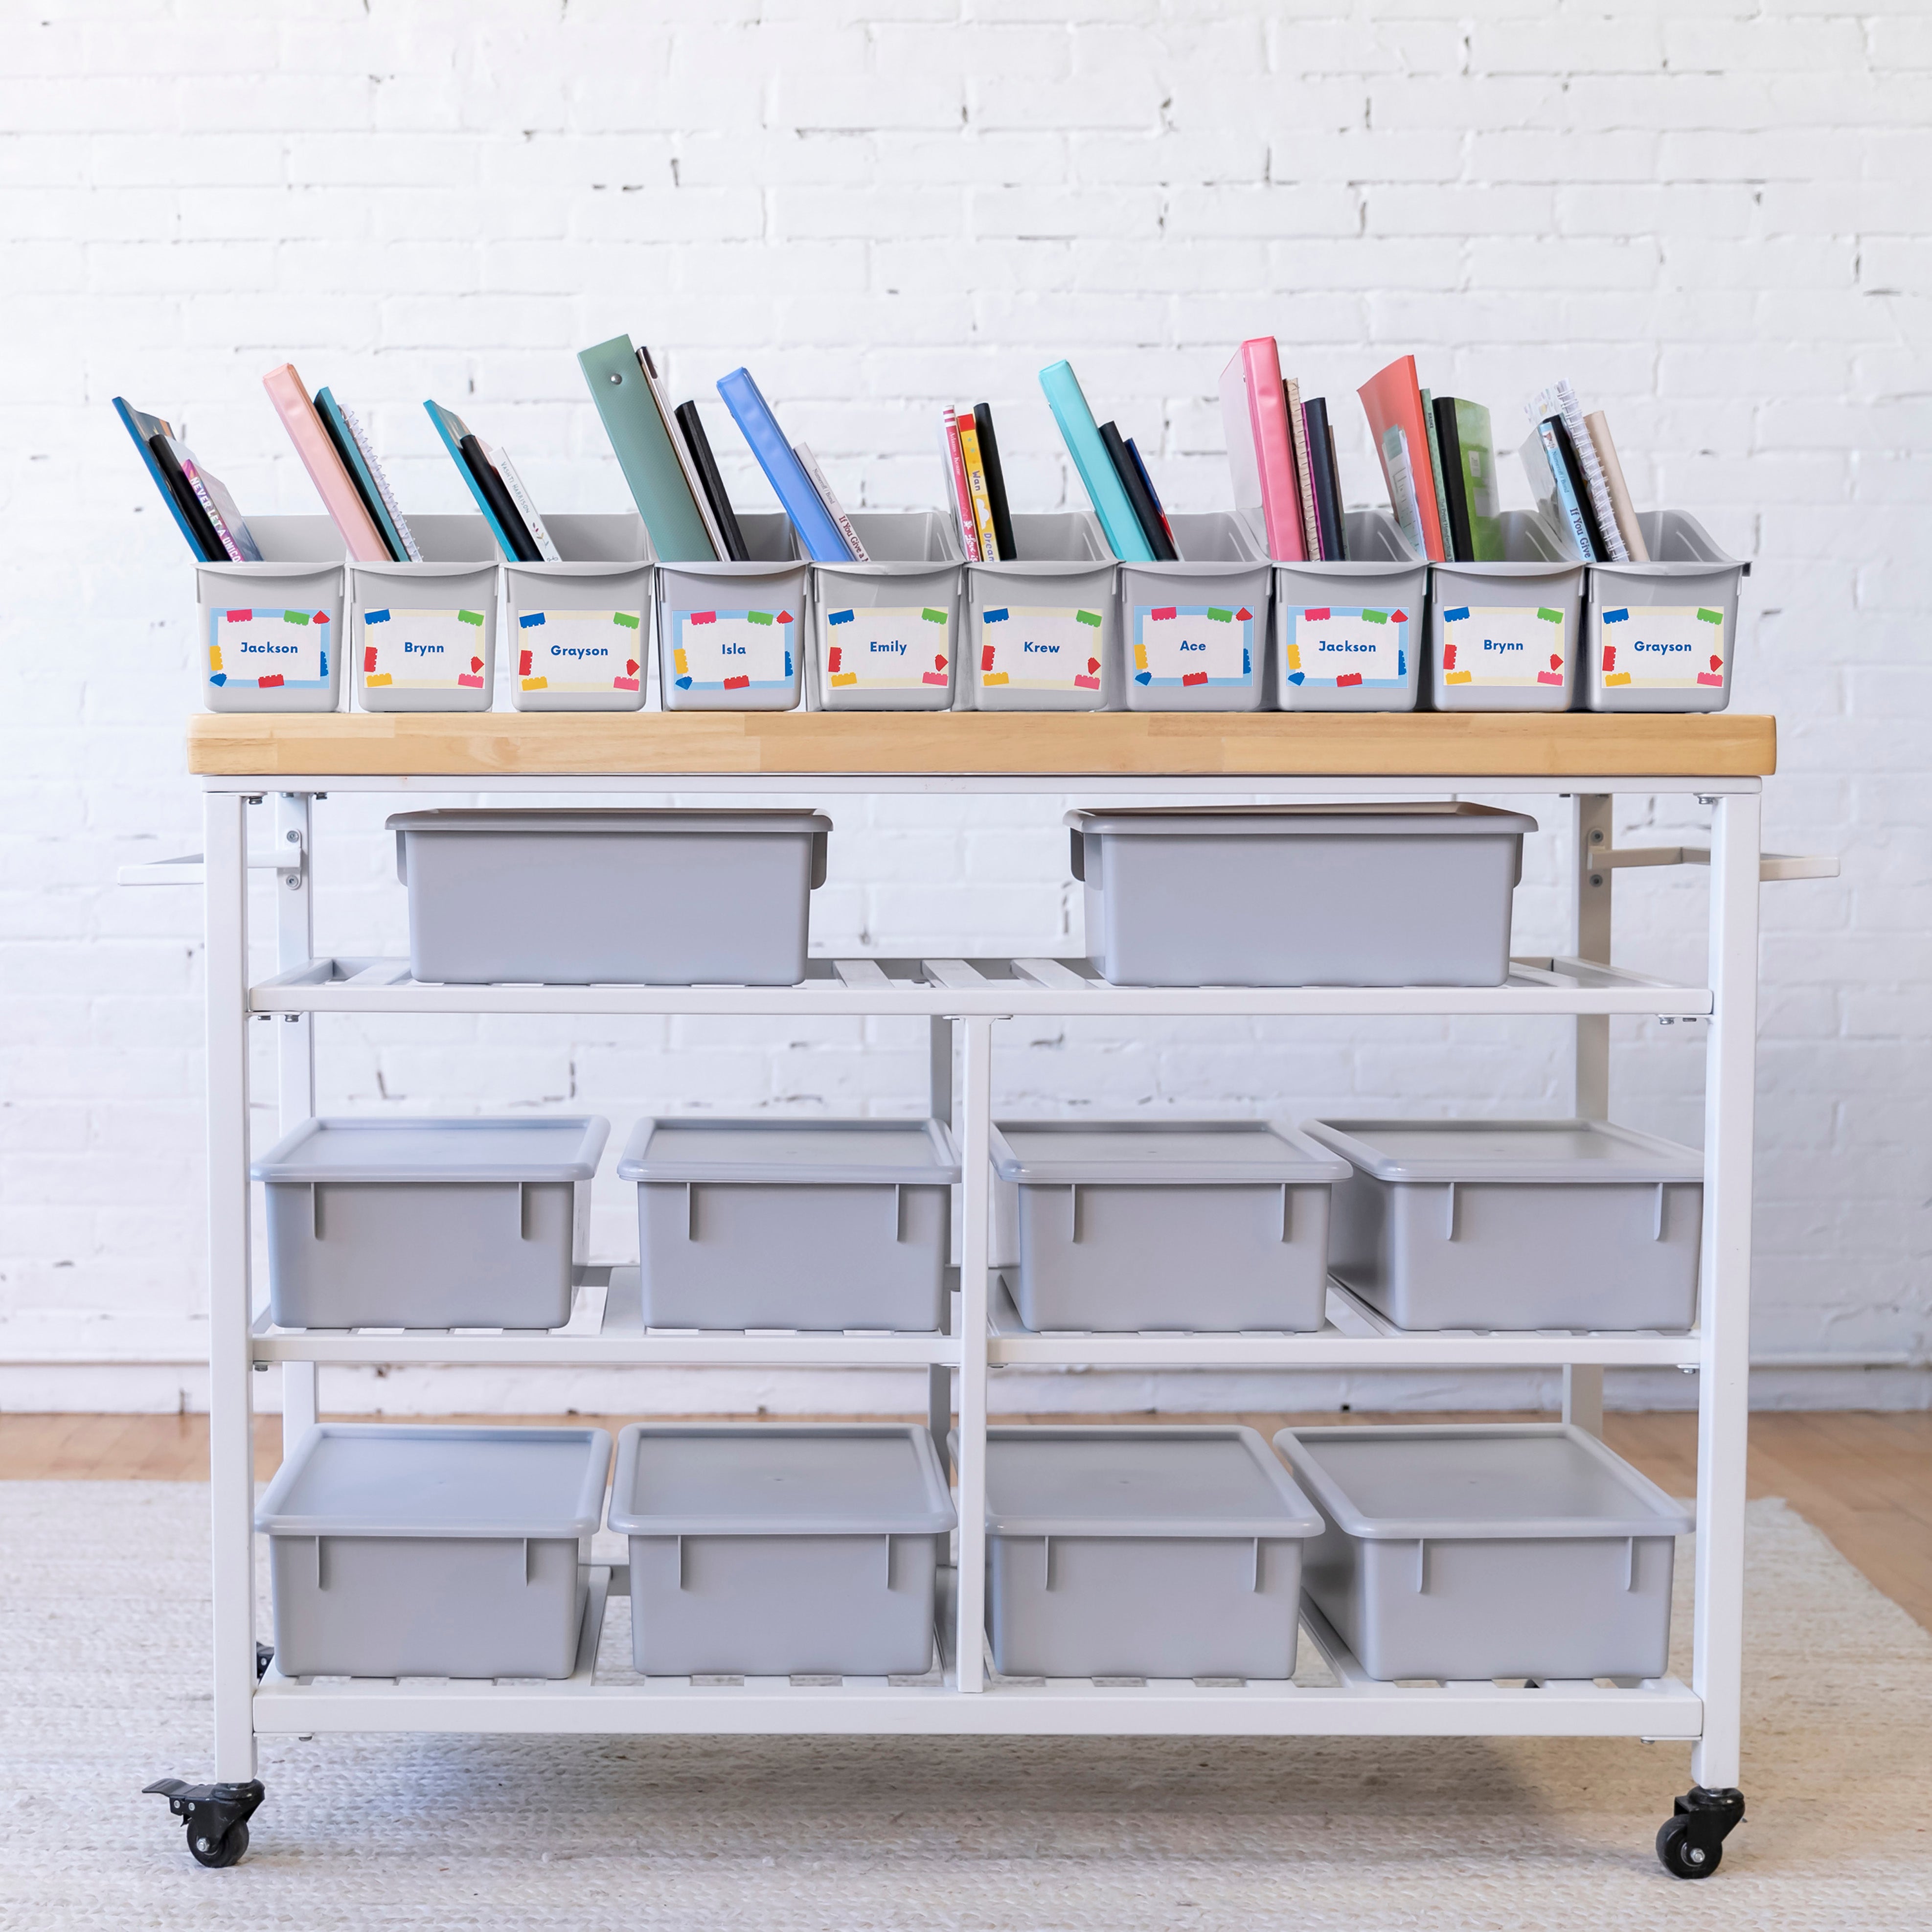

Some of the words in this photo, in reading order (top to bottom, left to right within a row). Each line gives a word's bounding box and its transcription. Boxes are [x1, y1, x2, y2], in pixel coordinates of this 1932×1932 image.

[501, 461, 514, 483] VASHTI
[512, 484, 530, 514] HARRISON
[812, 468, 828, 490] Numeroff
[826, 491, 836, 505] Bond
[972, 470, 981, 491] Wan
[190, 477, 213, 508] NEVER
[207, 509, 223, 528] LET
[218, 529, 226, 537] A
[1569, 507, 1580, 516] If
[1573, 517, 1584, 536] You
[843, 523, 853, 537] You
[850, 536, 862, 553] Give
[1580, 537, 1591, 558] Give
[240, 641, 298, 653] Jackson
[405, 642, 444, 657] Brynn
[550, 645, 608, 660] Grayson
[722, 642, 747, 655] Isla
[870, 640, 907, 656] Emily
[1024, 641, 1060, 653] Krew
[1180, 640, 1206, 651] Ace
[1318, 640, 1376, 652] Jackson
[1484, 639, 1523, 654] Brynn
[1634, 640, 1692, 656] Grayson
